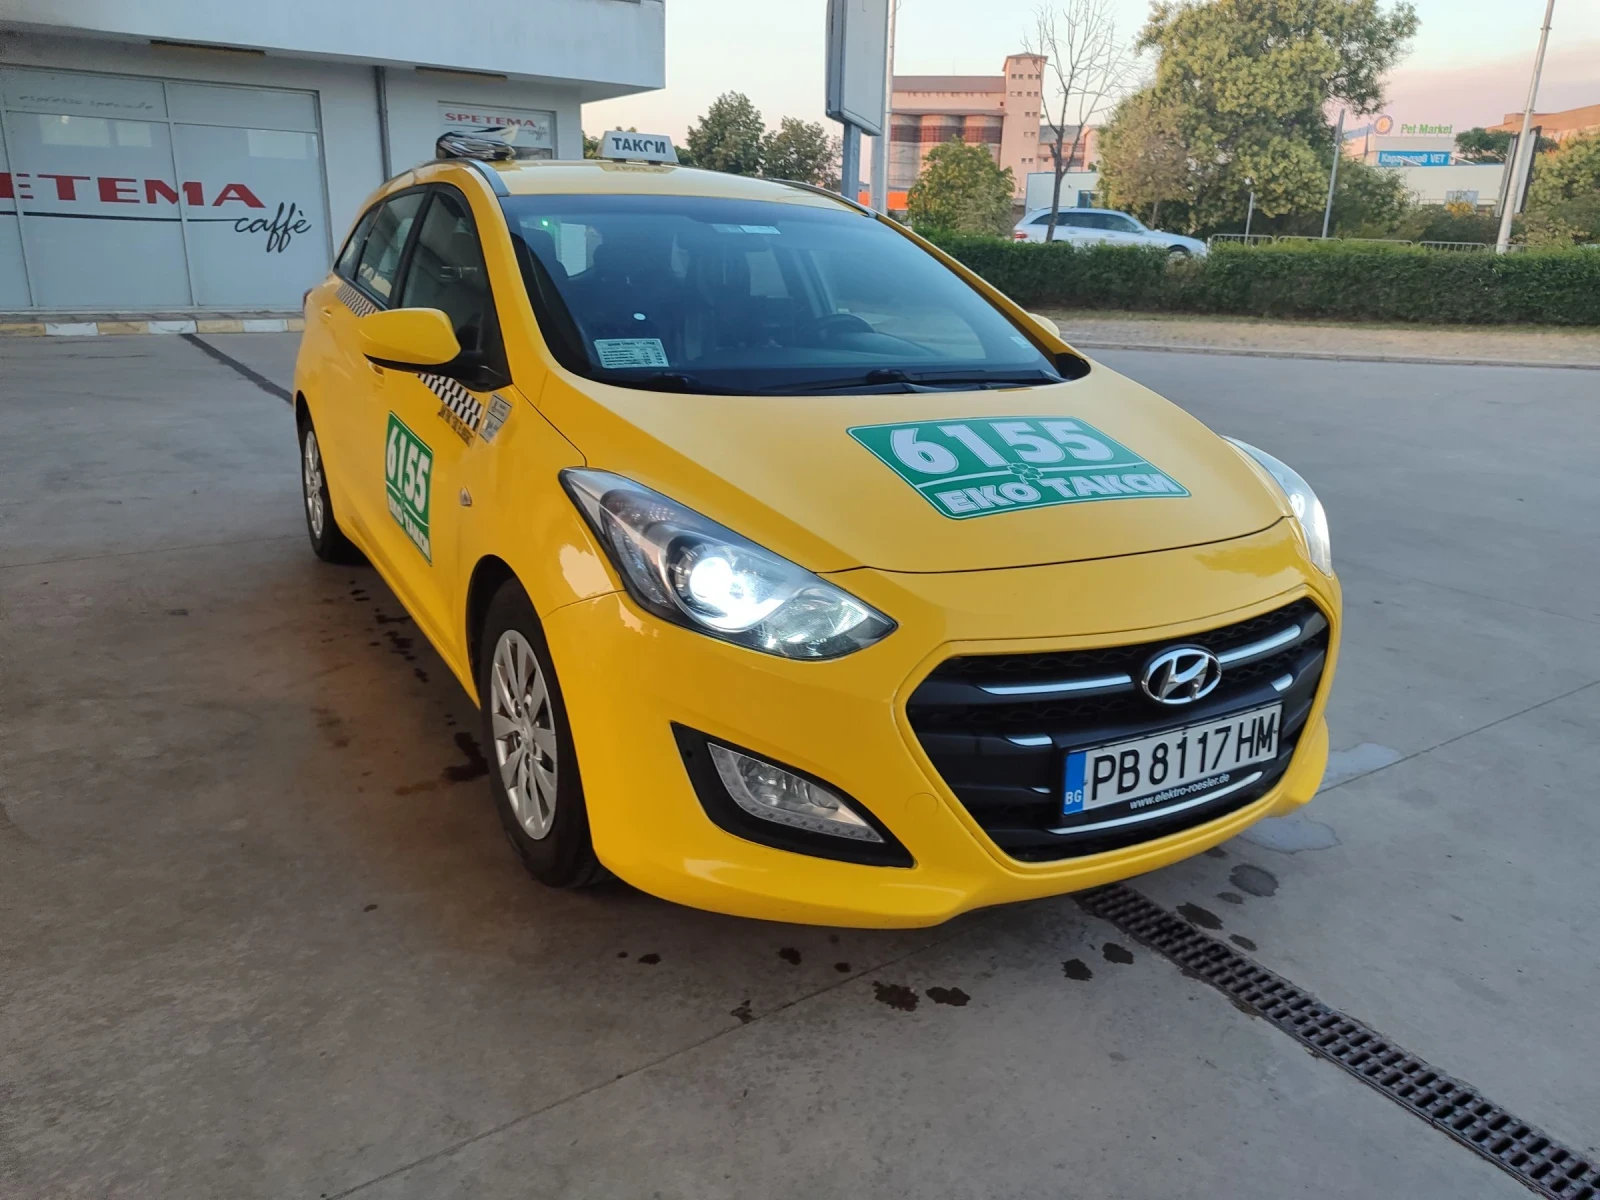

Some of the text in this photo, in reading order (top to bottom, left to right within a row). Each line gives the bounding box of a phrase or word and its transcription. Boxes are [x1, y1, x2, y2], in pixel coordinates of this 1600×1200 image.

[445, 112, 536, 128] SPETEMA
[1400, 123, 1453, 134] Pet Market
[611, 136, 667, 154] ТАКСИ
[1430, 153, 1447, 164] VET
[234, 202, 312, 253] caffè
[890, 421, 1113, 474] 6155
[386, 424, 431, 514] 6155
[934, 473, 1180, 514] ЕКО ТАКСИ
[1092, 712, 1276, 800] PB 8117 HM
[1065, 789, 1082, 805] BG
[1129, 772, 1230, 810] www.elektro-roesler.de
